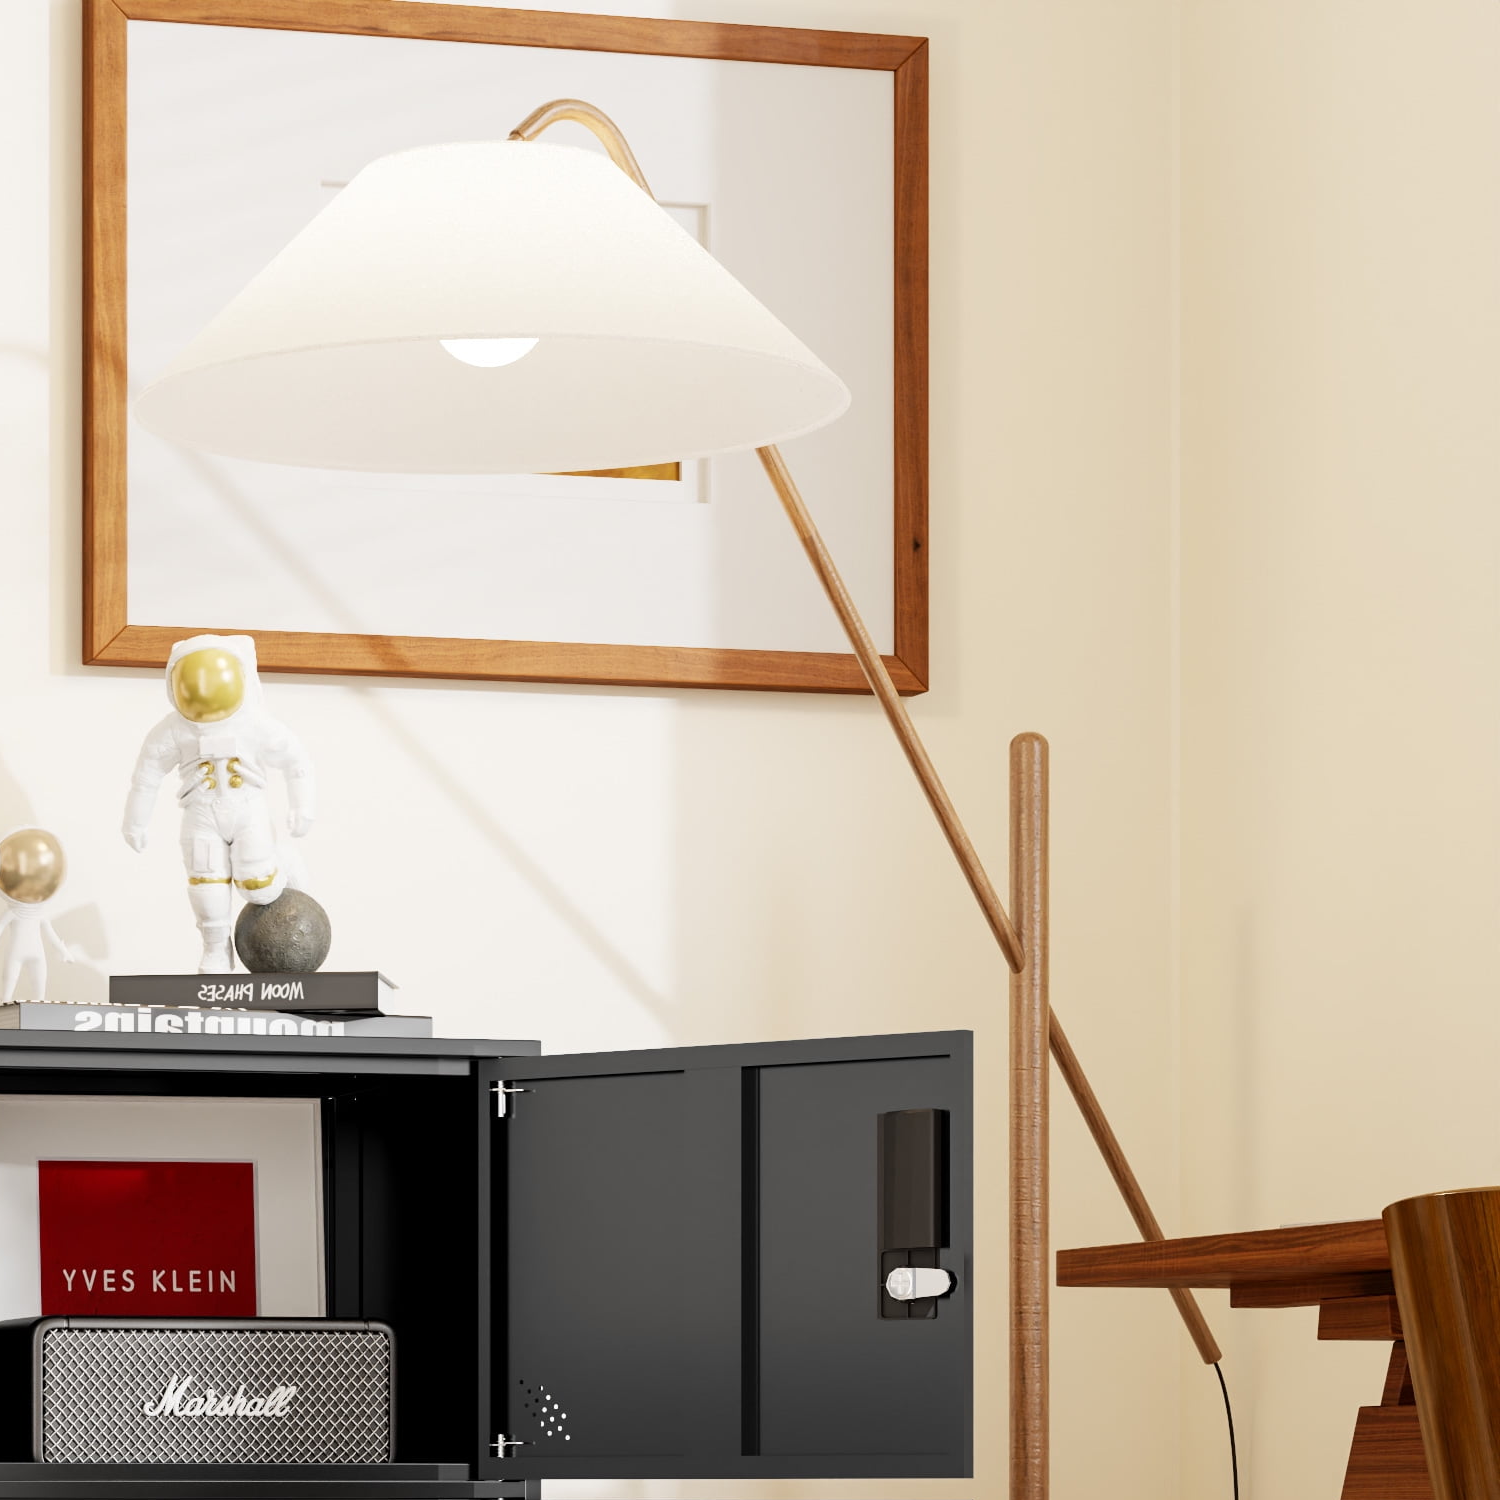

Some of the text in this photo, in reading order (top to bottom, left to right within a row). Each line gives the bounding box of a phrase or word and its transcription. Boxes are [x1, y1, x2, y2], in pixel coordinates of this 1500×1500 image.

[62, 1268, 236, 1293] YVES KLEIN
[143, 1373, 298, 1418] Marshall
